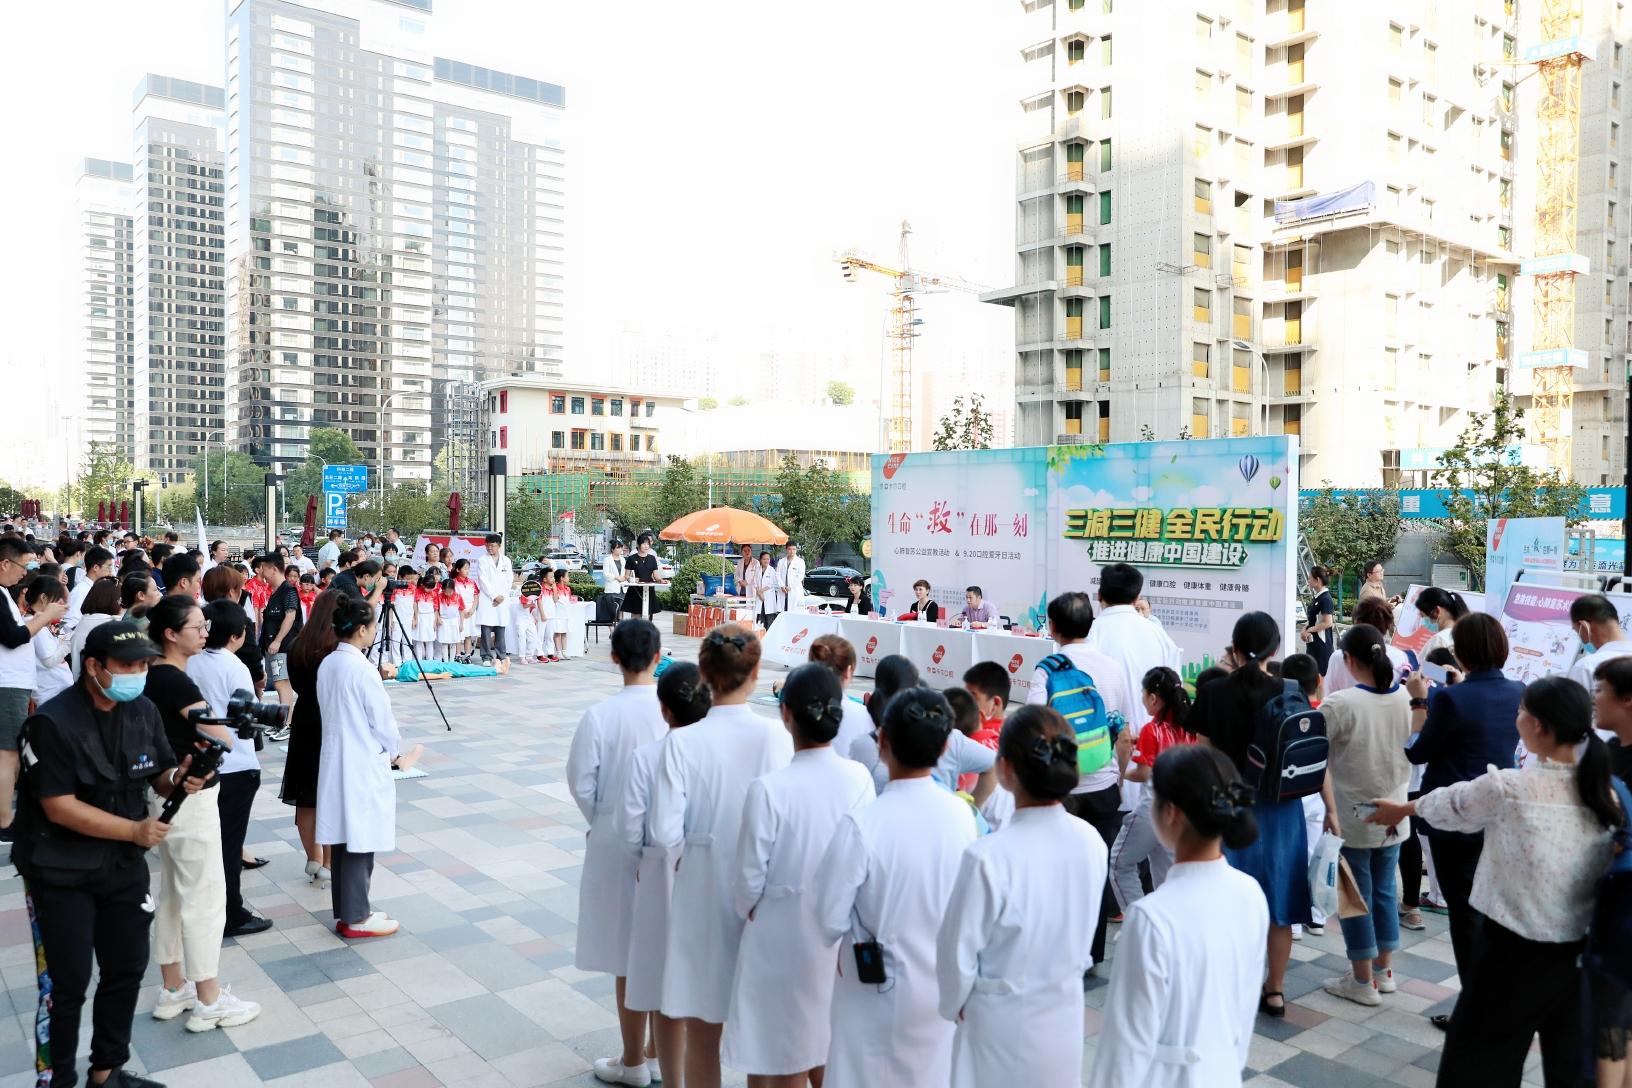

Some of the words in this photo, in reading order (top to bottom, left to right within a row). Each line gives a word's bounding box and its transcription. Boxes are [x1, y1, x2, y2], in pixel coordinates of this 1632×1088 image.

[328, 493, 343, 516] P
[1062, 508, 1162, 539] 三减三健
[1164, 508, 1285, 541] 全民行动
[1091, 541, 1244, 566] 推进健康中国建设
[1149, 579, 1177, 589] 健康口腔
[1183, 581, 1212, 591] 健康体重
